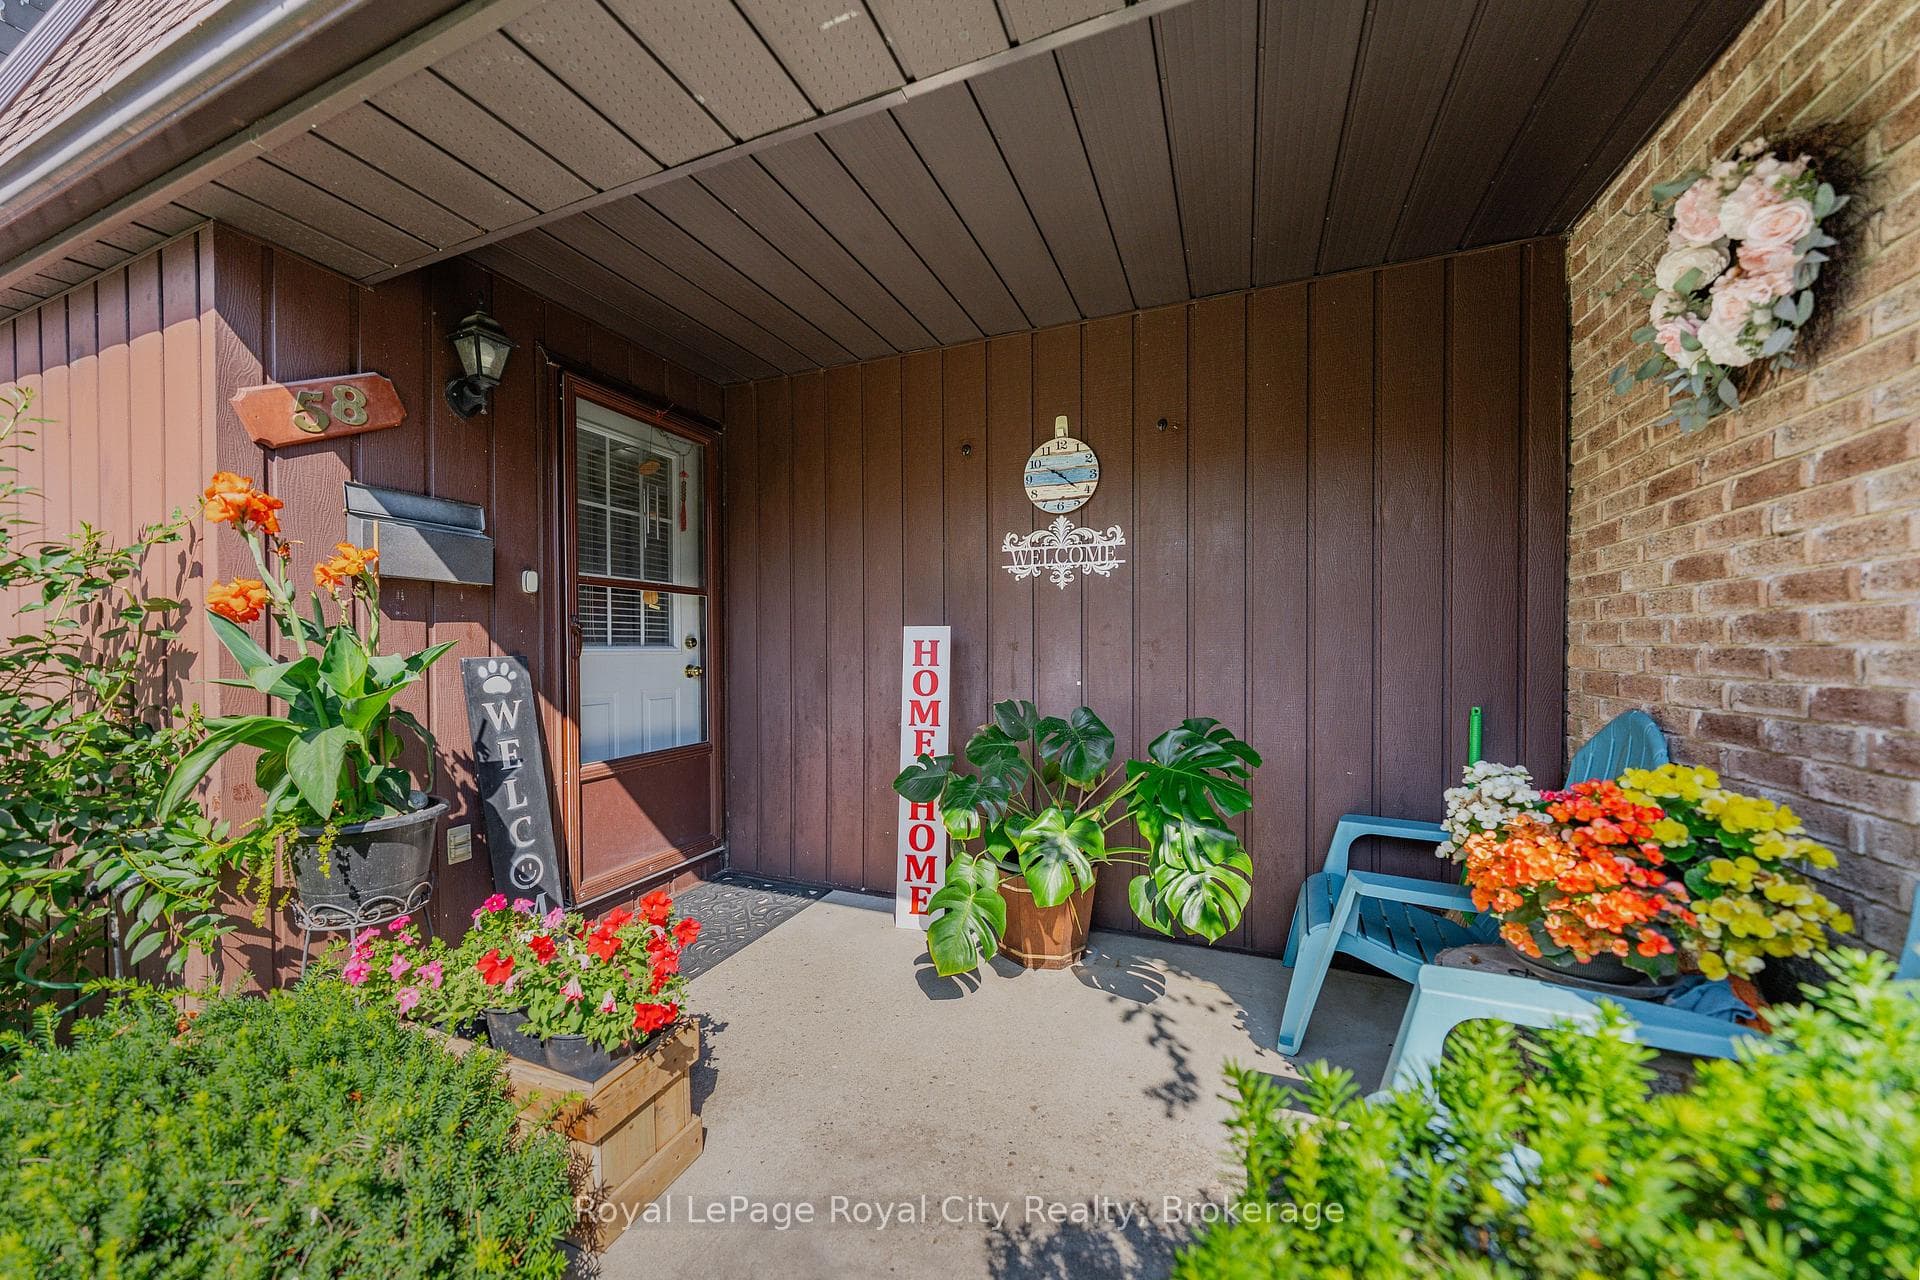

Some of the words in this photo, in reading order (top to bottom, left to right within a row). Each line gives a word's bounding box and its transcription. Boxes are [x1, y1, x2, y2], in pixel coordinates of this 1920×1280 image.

[293, 384, 369, 433] 58
[1056, 440, 1068, 450] 12
[1041, 446, 1051, 456] 11
[1085, 453, 1093, 463] 2
[1029, 460, 1042, 469] 10
[1089, 469, 1098, 479] 3
[1025, 475, 1033, 485] 9
[1031, 490, 1038, 499] 8
[1057, 502, 1065, 511] 6
[1010, 544, 1117, 568] WELCOME
[908, 639, 941, 757] HOME
[481, 700, 548, 917] WELCO
[904, 801, 938, 915] HOME
